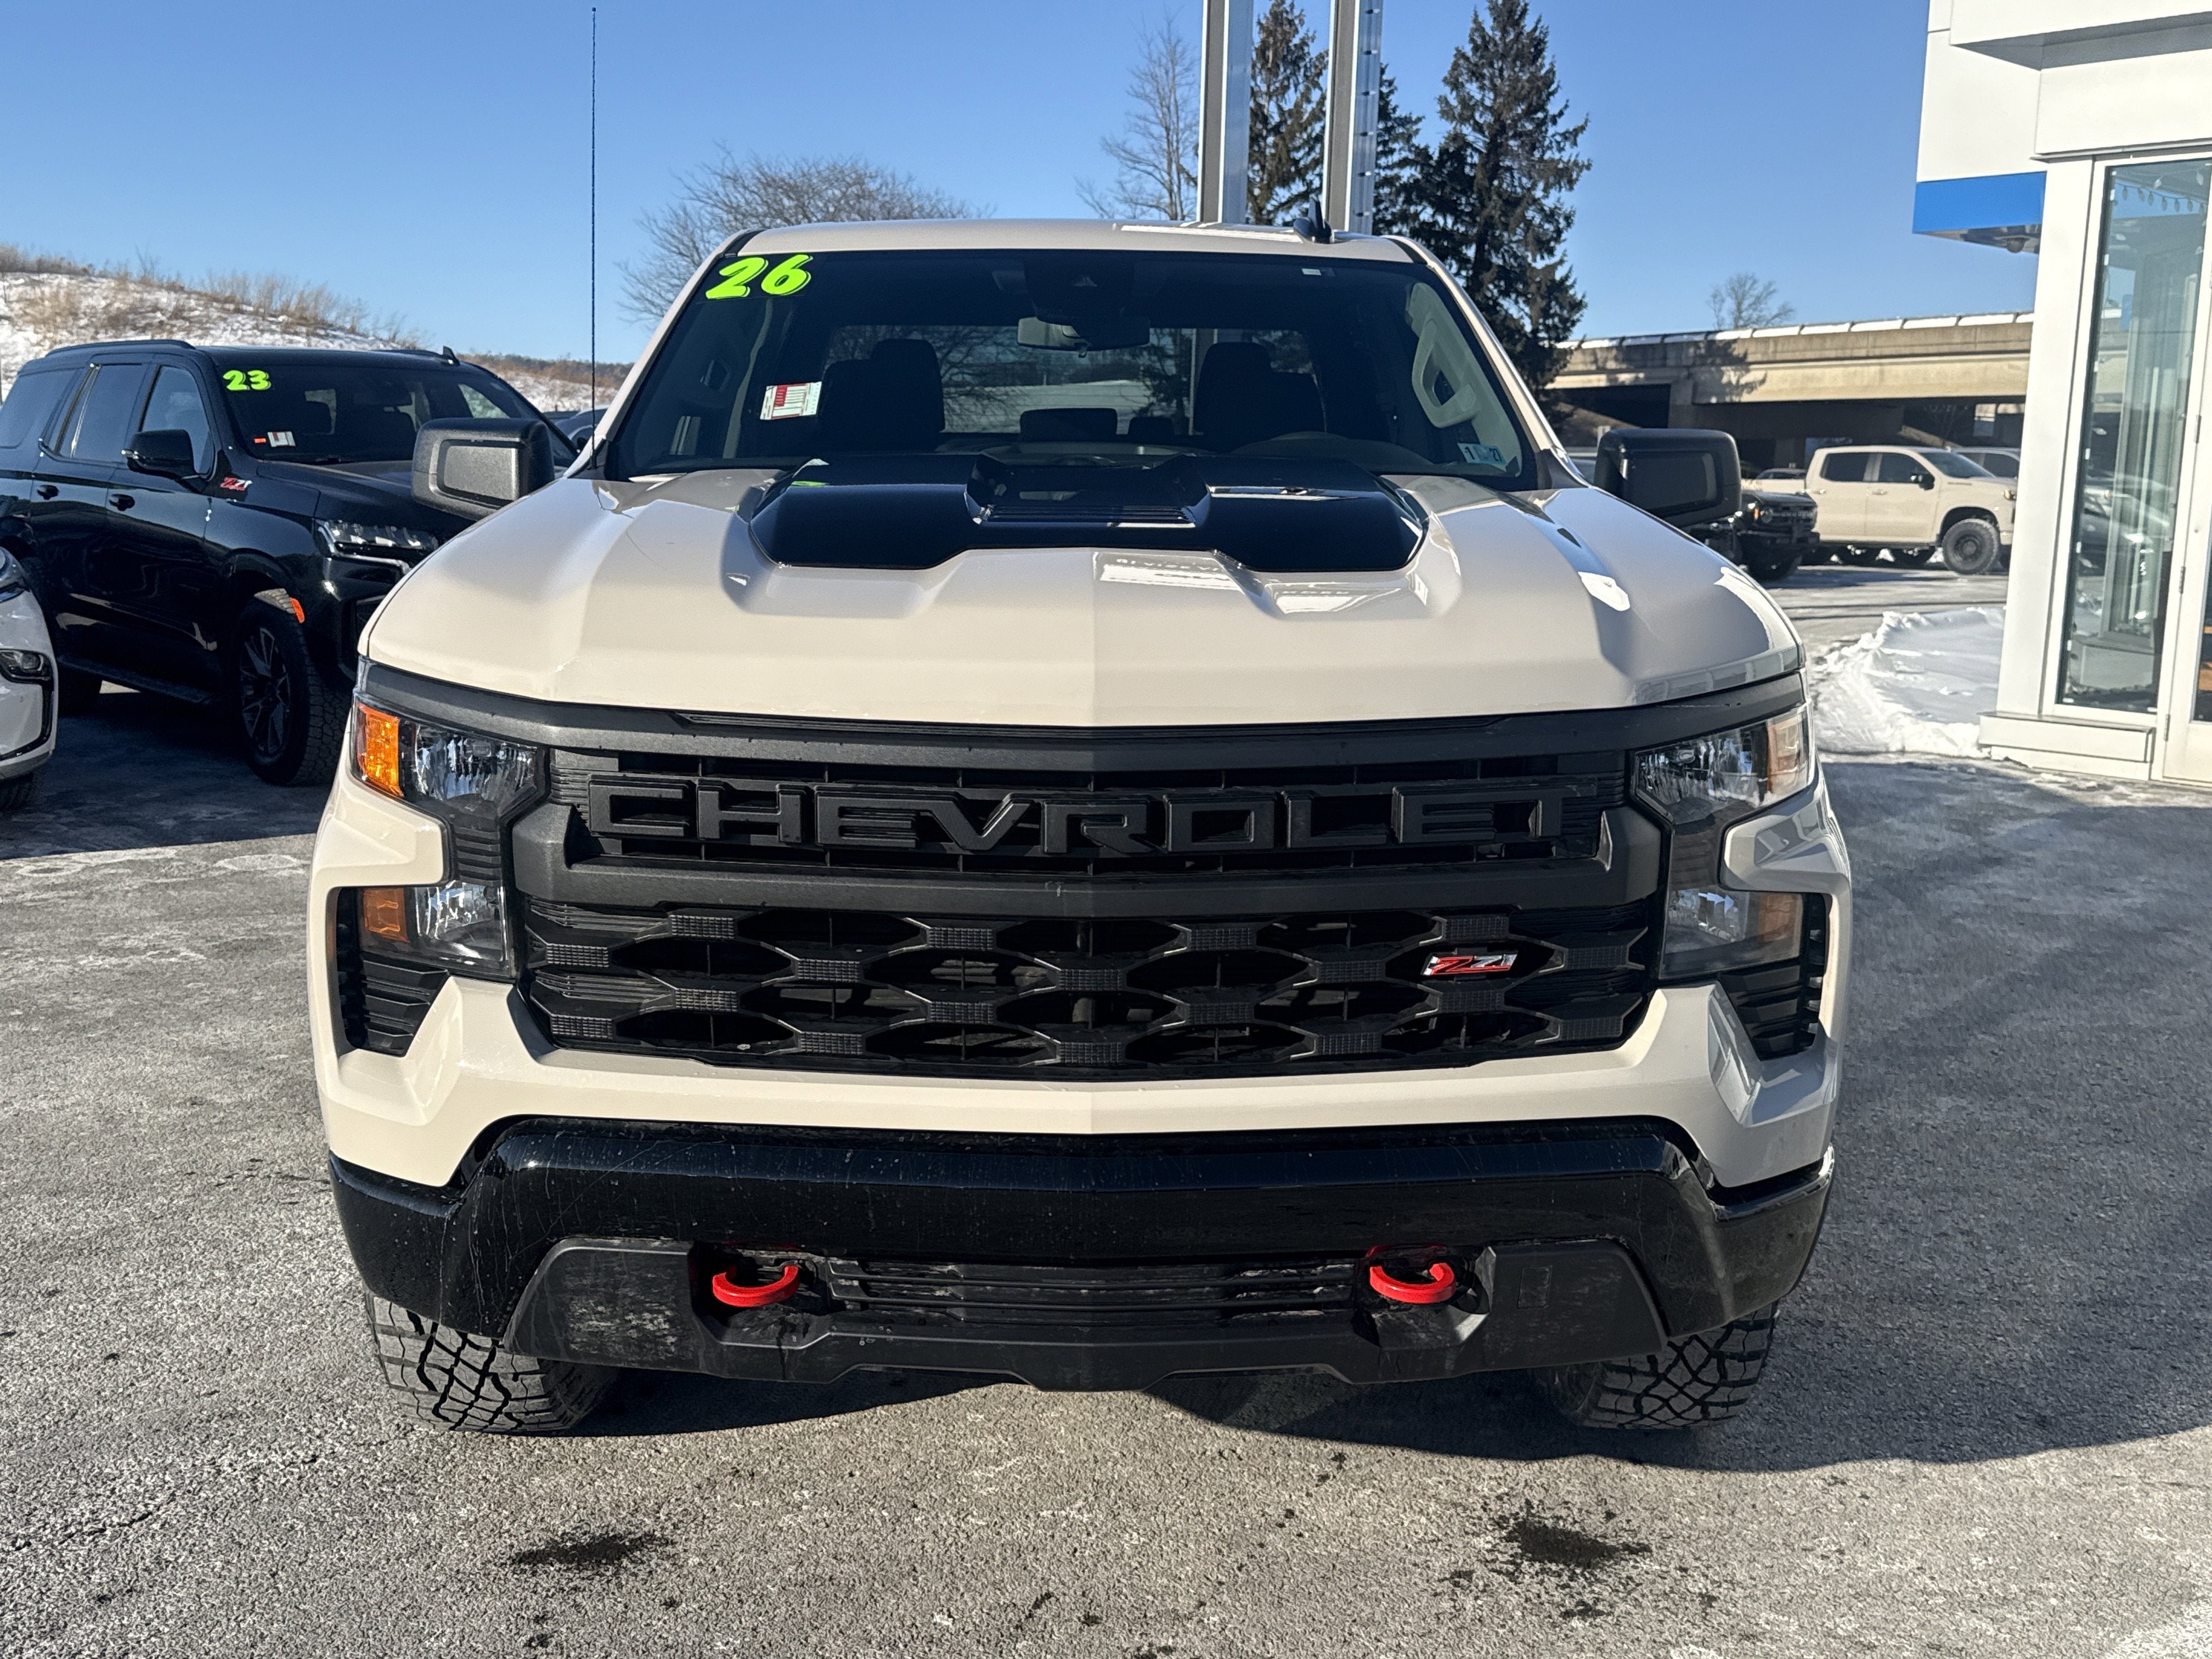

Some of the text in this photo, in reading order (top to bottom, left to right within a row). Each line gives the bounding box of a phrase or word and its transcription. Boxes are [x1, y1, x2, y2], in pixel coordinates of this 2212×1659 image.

[706, 255, 814, 299] 26
[223, 370, 271, 391] 23
[221, 477, 253, 490] Z71
[589, 775, 1584, 854] CHEVROLET
[1422, 952, 1518, 975] Z71
